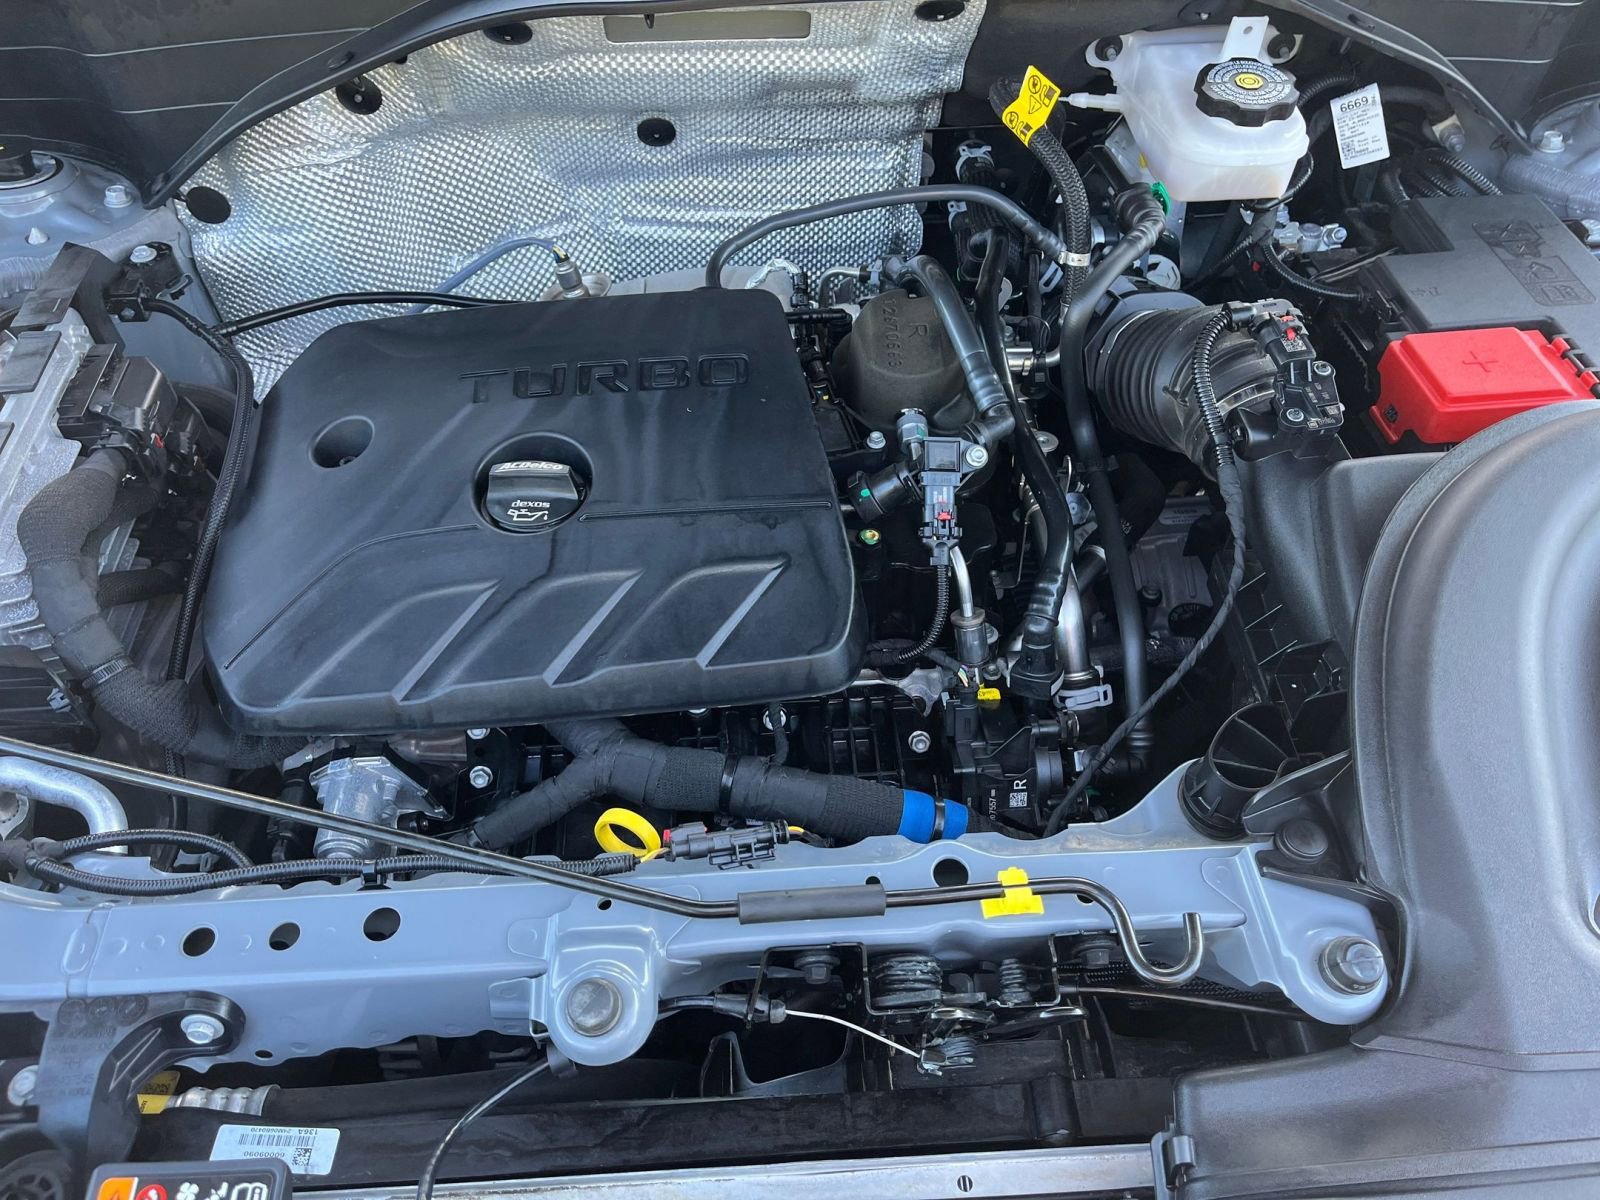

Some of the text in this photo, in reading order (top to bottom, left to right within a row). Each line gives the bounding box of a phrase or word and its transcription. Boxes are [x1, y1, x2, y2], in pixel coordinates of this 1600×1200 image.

[1340, 96, 1369, 112] 6669
[907, 322, 929, 338] R
[458, 353, 749, 404] TURBO
[499, 461, 563, 470] ACDelco
[511, 499, 551, 508] dexos
[1013, 779, 1027, 790] R
[298, 1127, 318, 1136] 136A
